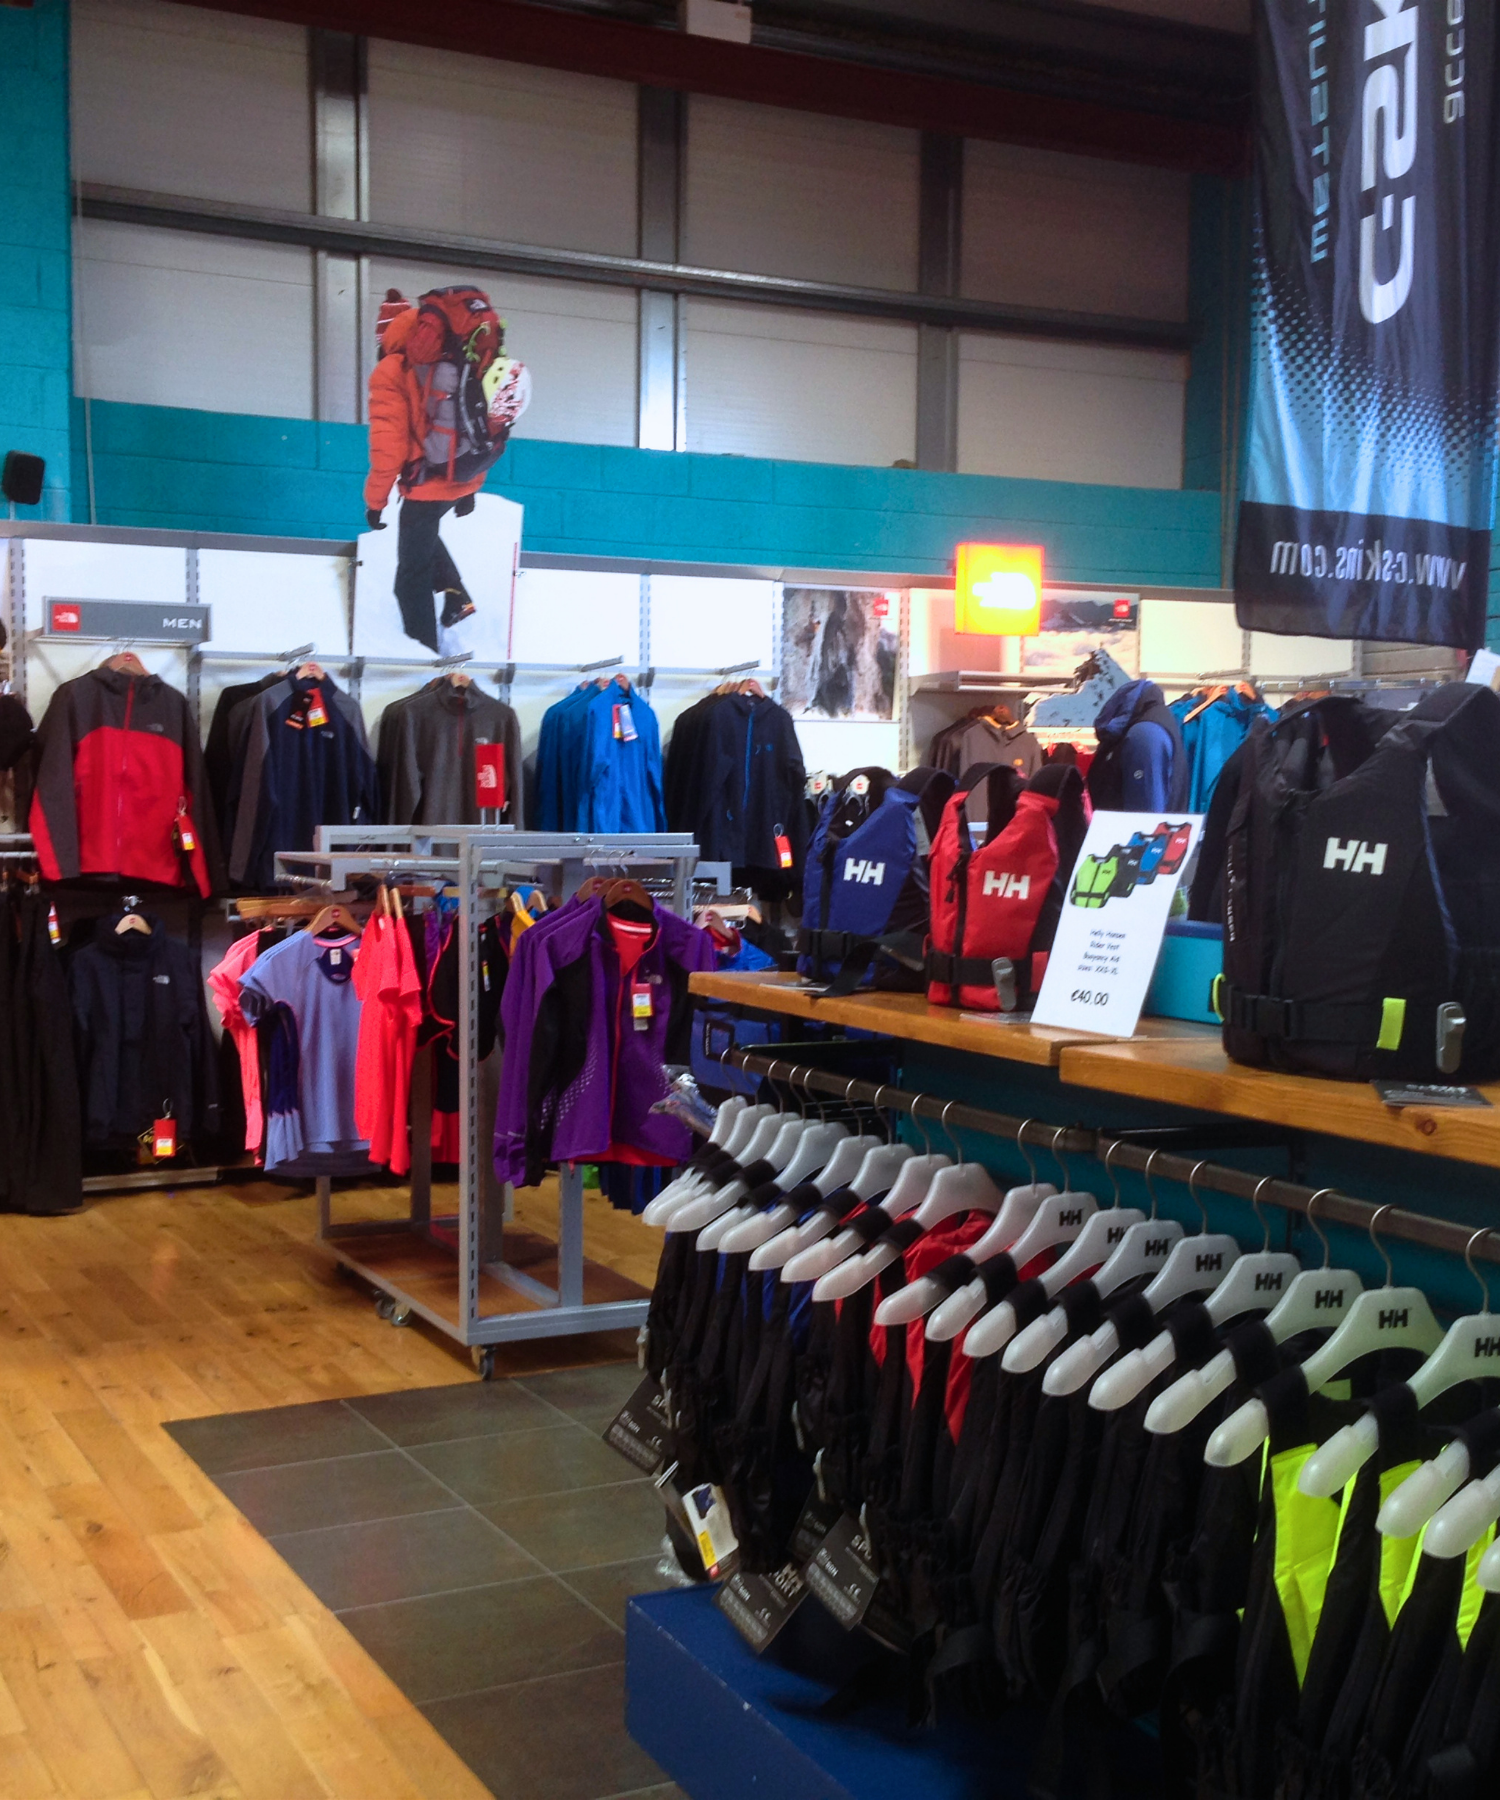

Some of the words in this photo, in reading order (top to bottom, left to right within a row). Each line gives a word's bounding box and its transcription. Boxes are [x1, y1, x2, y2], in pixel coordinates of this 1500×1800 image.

[162, 617, 203, 630] MEN
[1323, 836, 1389, 876] HH
[843, 857, 886, 886] HH
[982, 870, 1032, 900] HH
[1070, 988, 1109, 1007] €40.00
[1059, 1209, 1083, 1227] HH
[1144, 1238, 1169, 1258] HH
[1196, 1253, 1223, 1273] HH
[1255, 1272, 1283, 1292] HH
[1315, 1289, 1344, 1309] HH
[1378, 1308, 1409, 1330] HH
